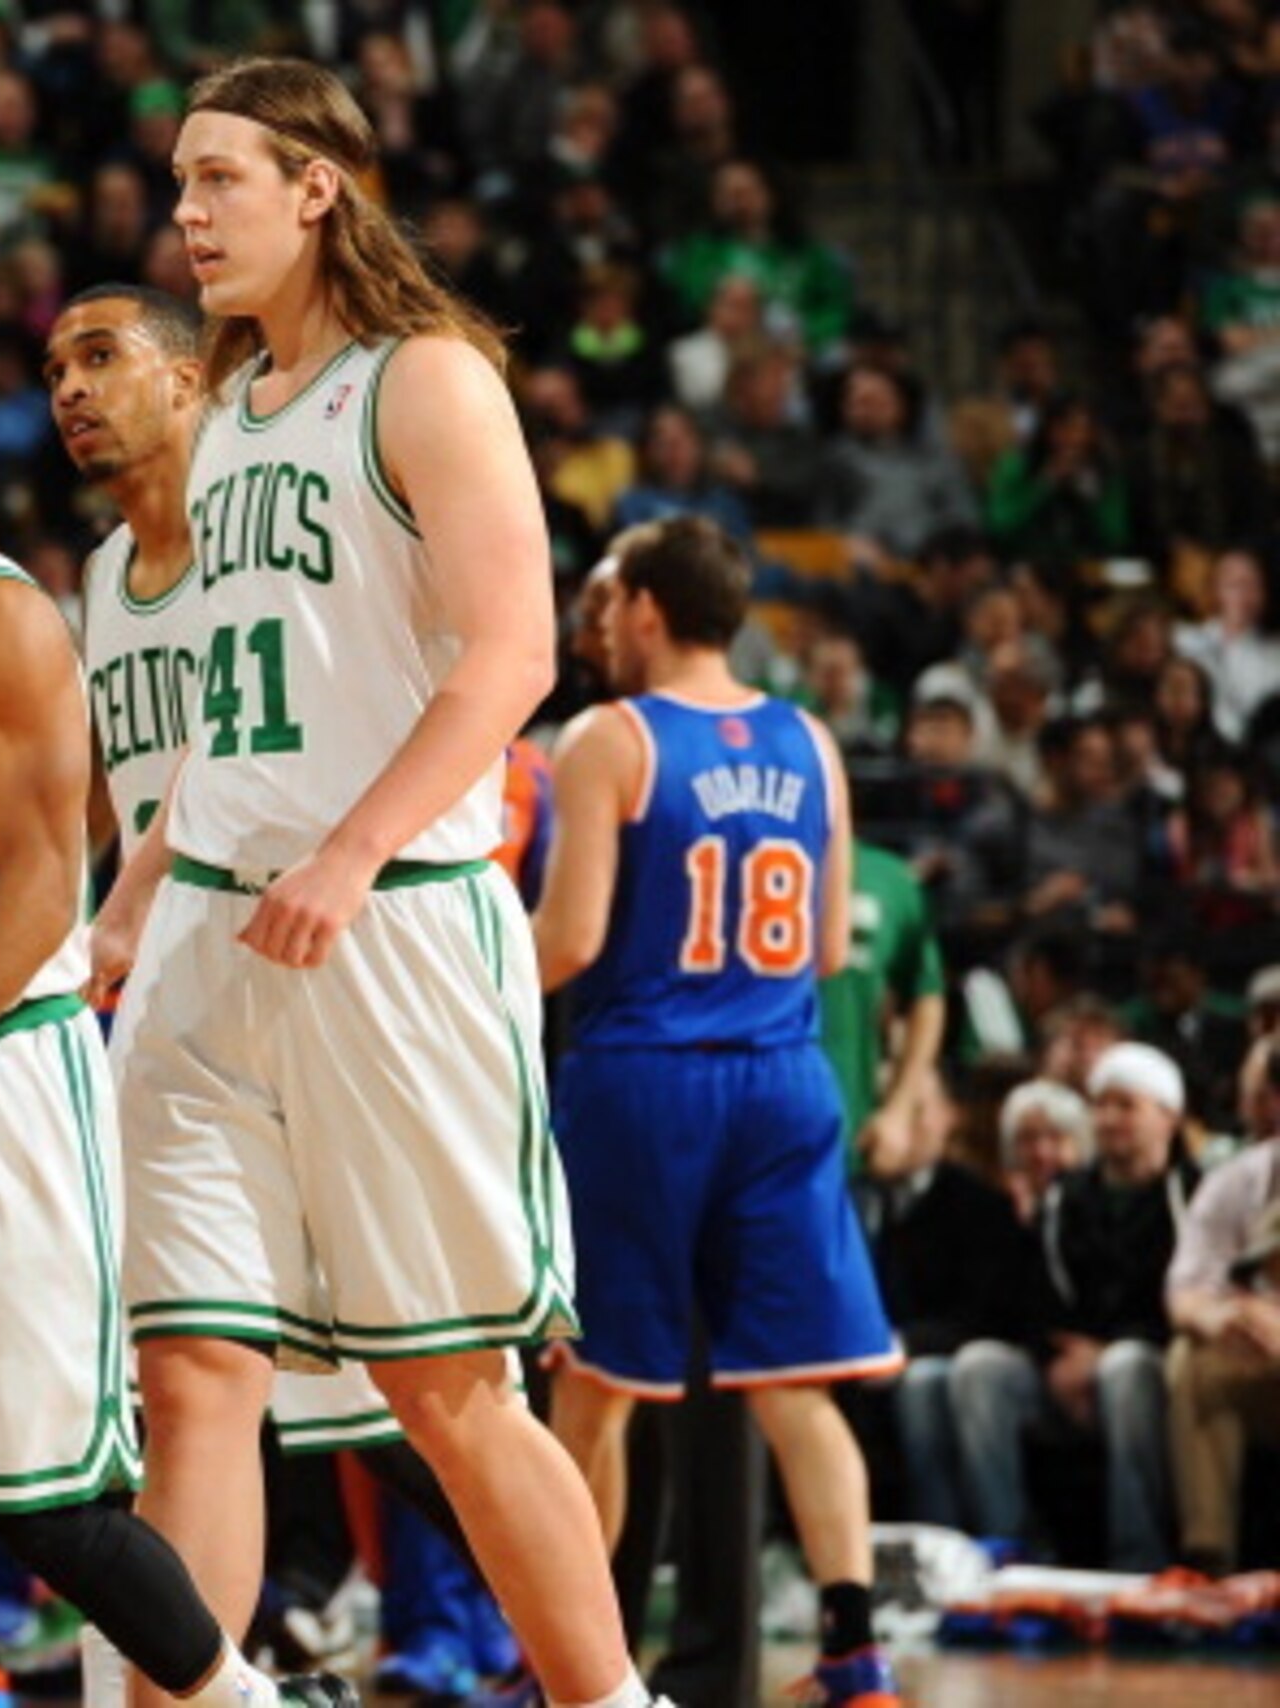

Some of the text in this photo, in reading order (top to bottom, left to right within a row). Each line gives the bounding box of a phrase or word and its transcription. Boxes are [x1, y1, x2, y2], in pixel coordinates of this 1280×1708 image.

[191, 462, 334, 592] ELTICS
[90, 645, 205, 772] CELTIC
[203, 617, 303, 758] 41
[680, 834, 813, 976] 18
